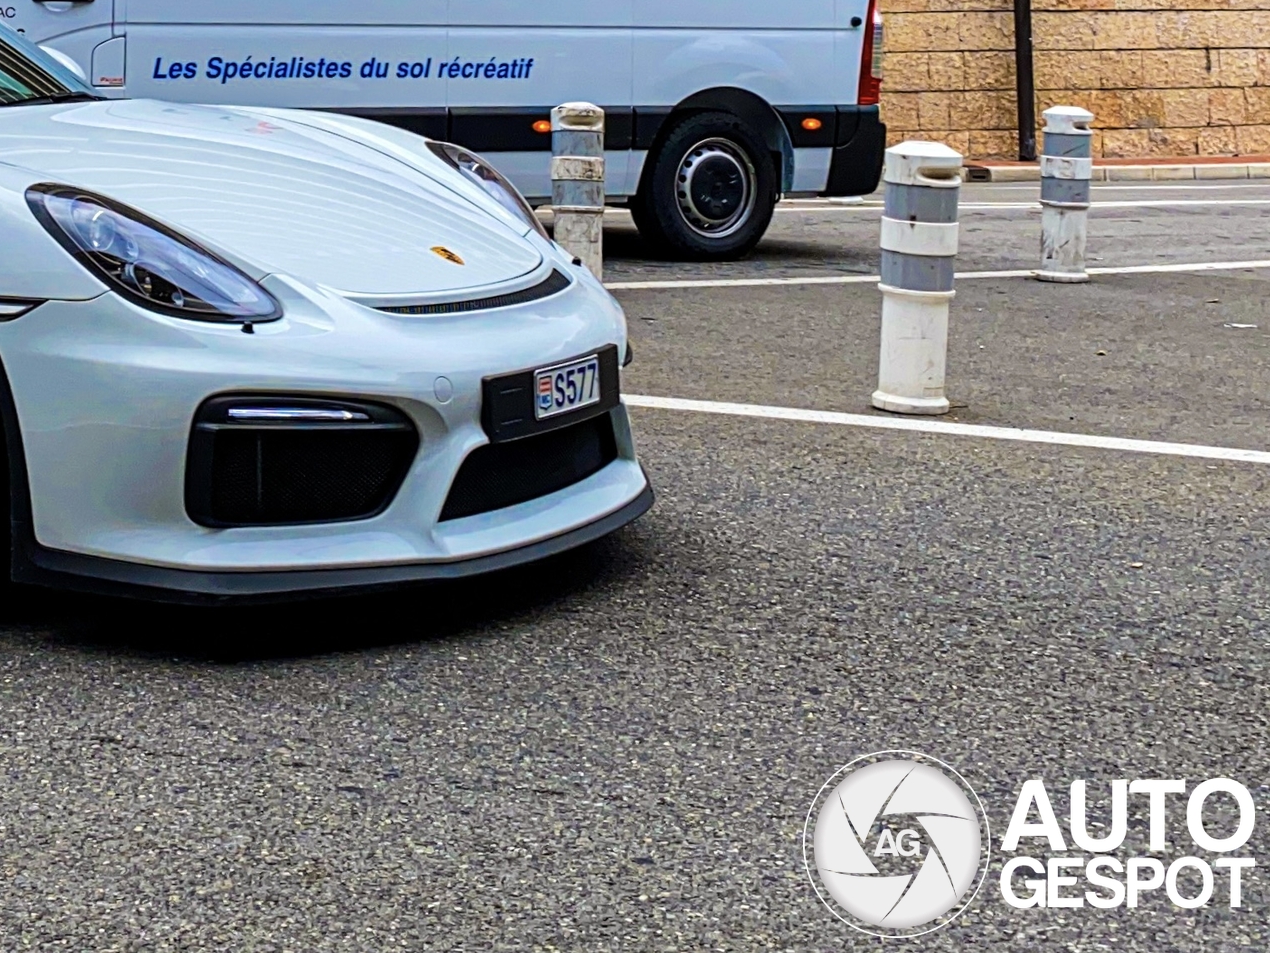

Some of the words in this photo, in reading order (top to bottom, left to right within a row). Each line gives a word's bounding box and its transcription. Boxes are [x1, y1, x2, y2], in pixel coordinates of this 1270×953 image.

[152, 56, 197, 79] Les
[205, 55, 352, 84] Spécialistes
[360, 57, 389, 79] du
[396, 57, 432, 79] sol
[437, 57, 534, 79] récréatif
[555, 363, 596, 407] S577
